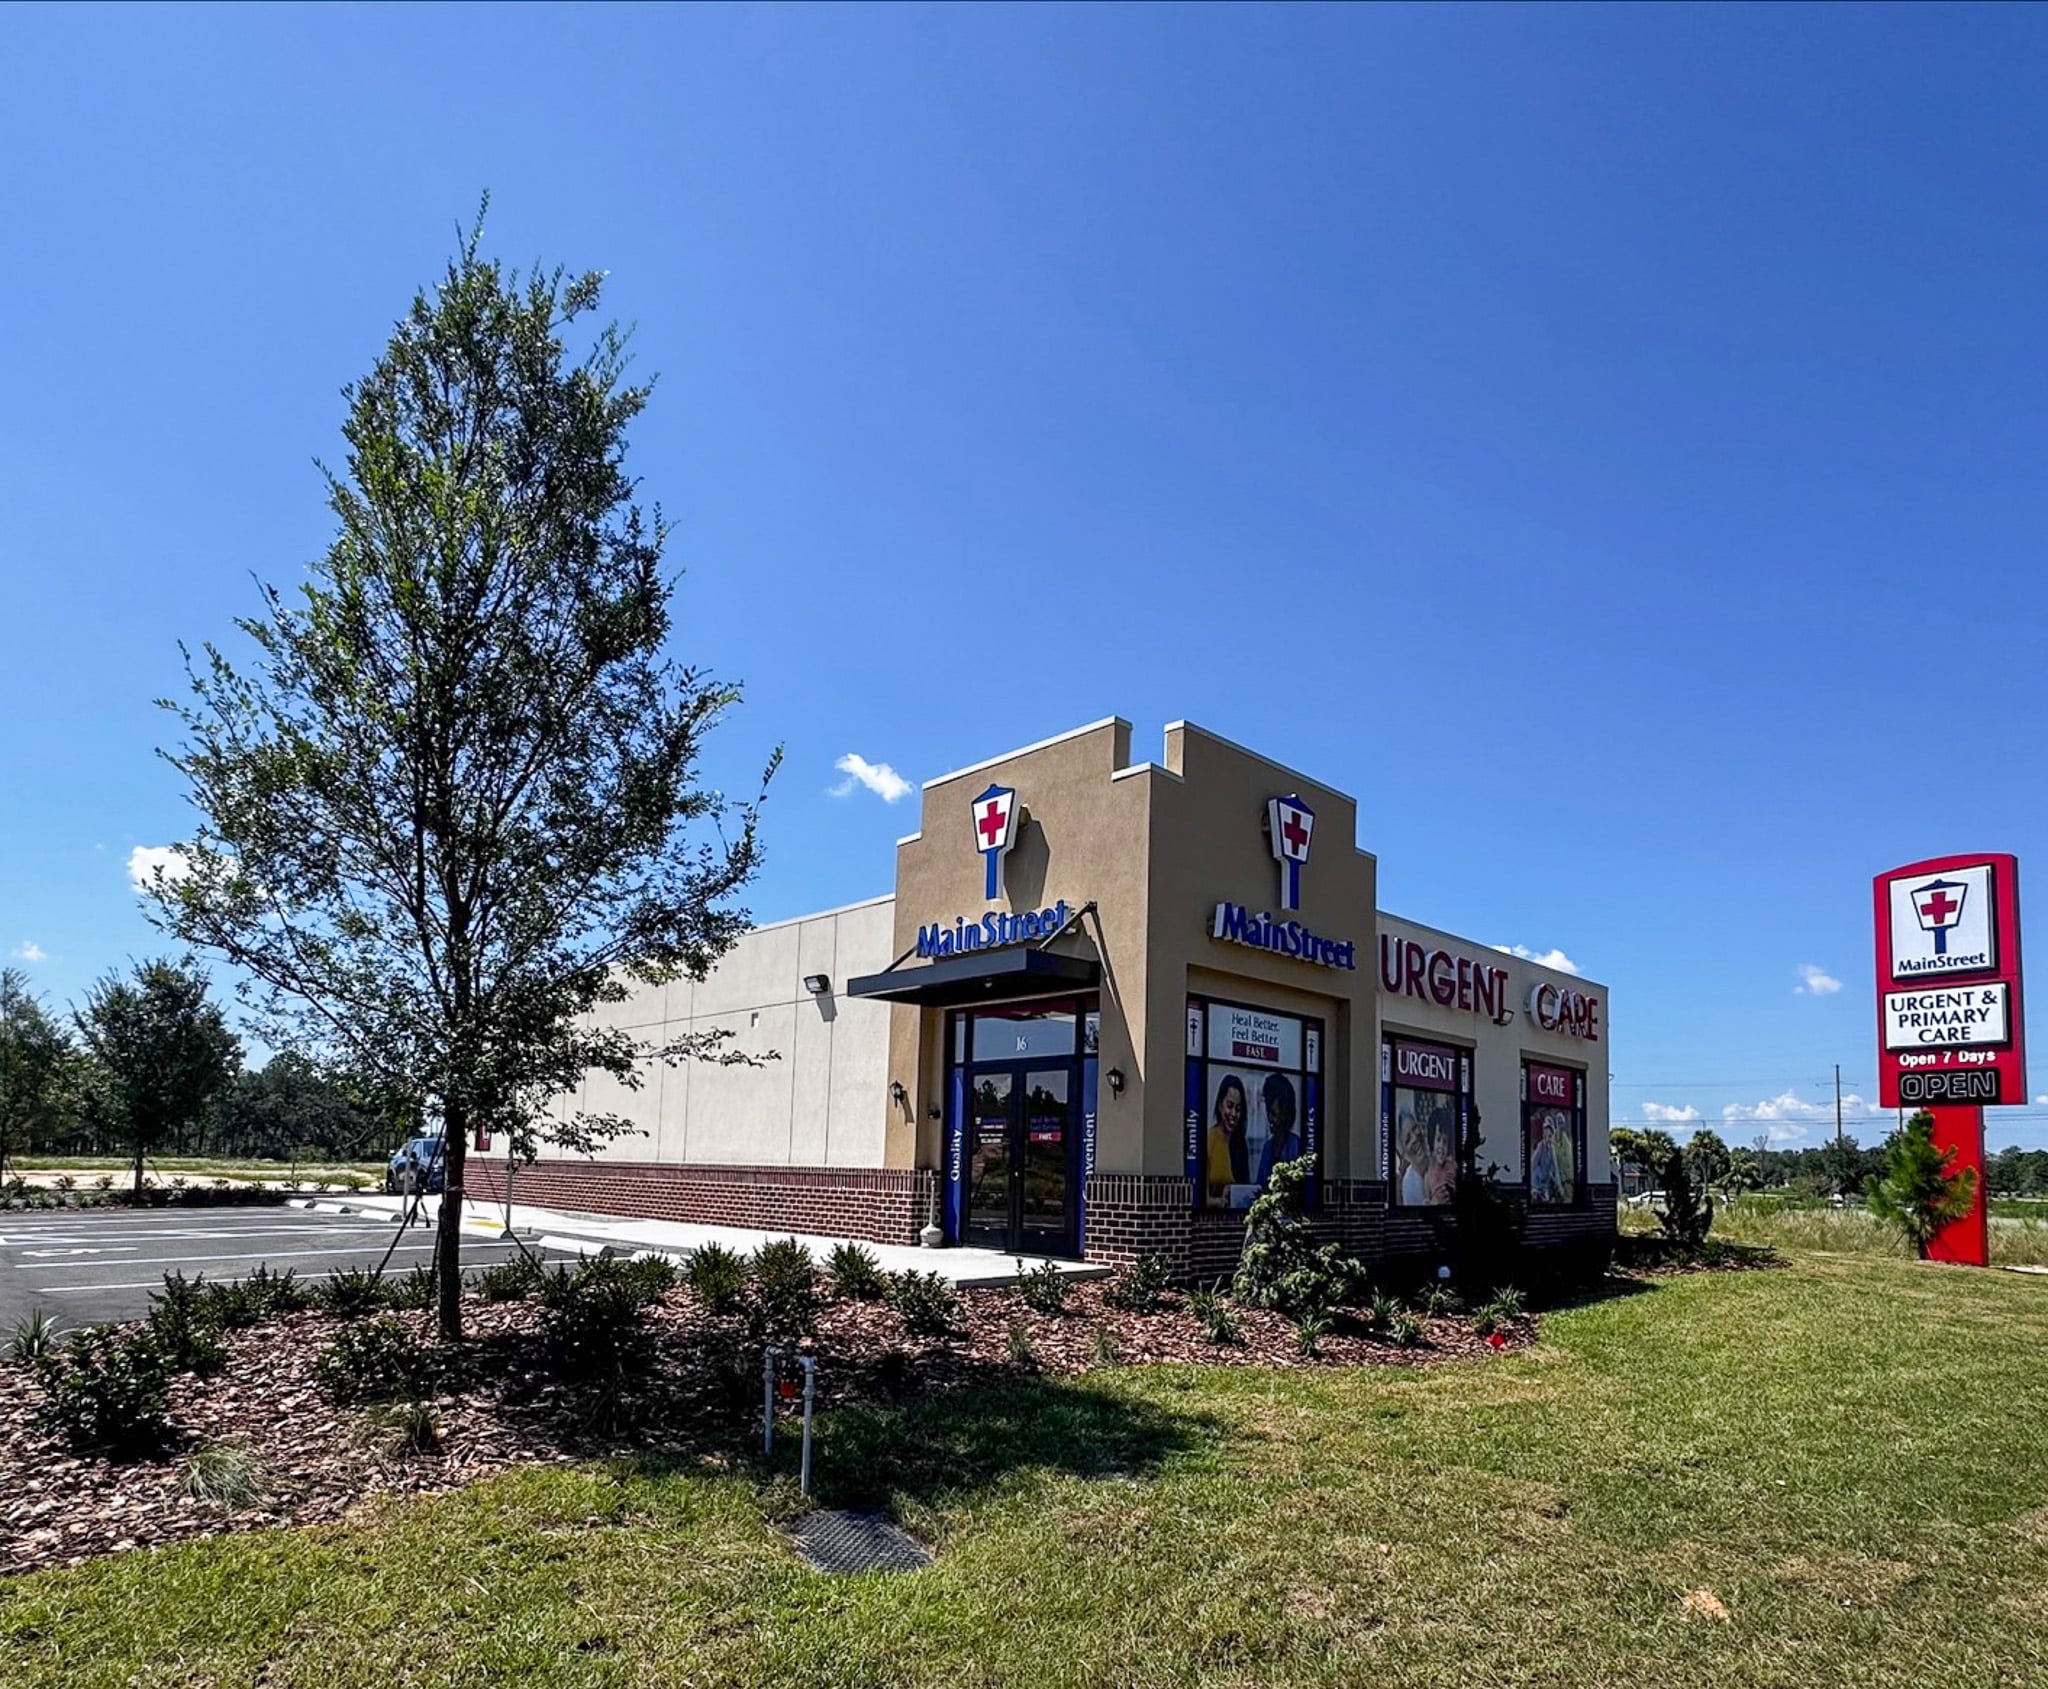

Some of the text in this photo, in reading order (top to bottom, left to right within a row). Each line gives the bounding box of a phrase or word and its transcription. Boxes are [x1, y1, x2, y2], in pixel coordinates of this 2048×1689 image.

[916, 899, 1069, 958] MainStreet
[1219, 902, 1355, 970] MainStreet
[1898, 952, 1986, 973] MainStreet
[1381, 934, 1598, 1041] URGENT CARE
[1891, 990, 1998, 1012] URGENT &
[1232, 1012, 1252, 1027] Heal
[1898, 1007, 1990, 1028] PRIMARY
[1016, 1036, 1027, 1051] 16
[1232, 1026, 1249, 1041] Feel
[1918, 1026, 1971, 1043] CARE
[1397, 1049, 1455, 1081] URGENT
[1899, 1050, 1996, 1068] Open 7 Days
[1537, 1073, 1565, 1097] CARE
[1900, 1071, 1996, 1100] OPEN
[1187, 1109, 1200, 1159] Family
[950, 1129, 963, 1181] Quality
[1381, 1112, 1389, 1181] Affordable
